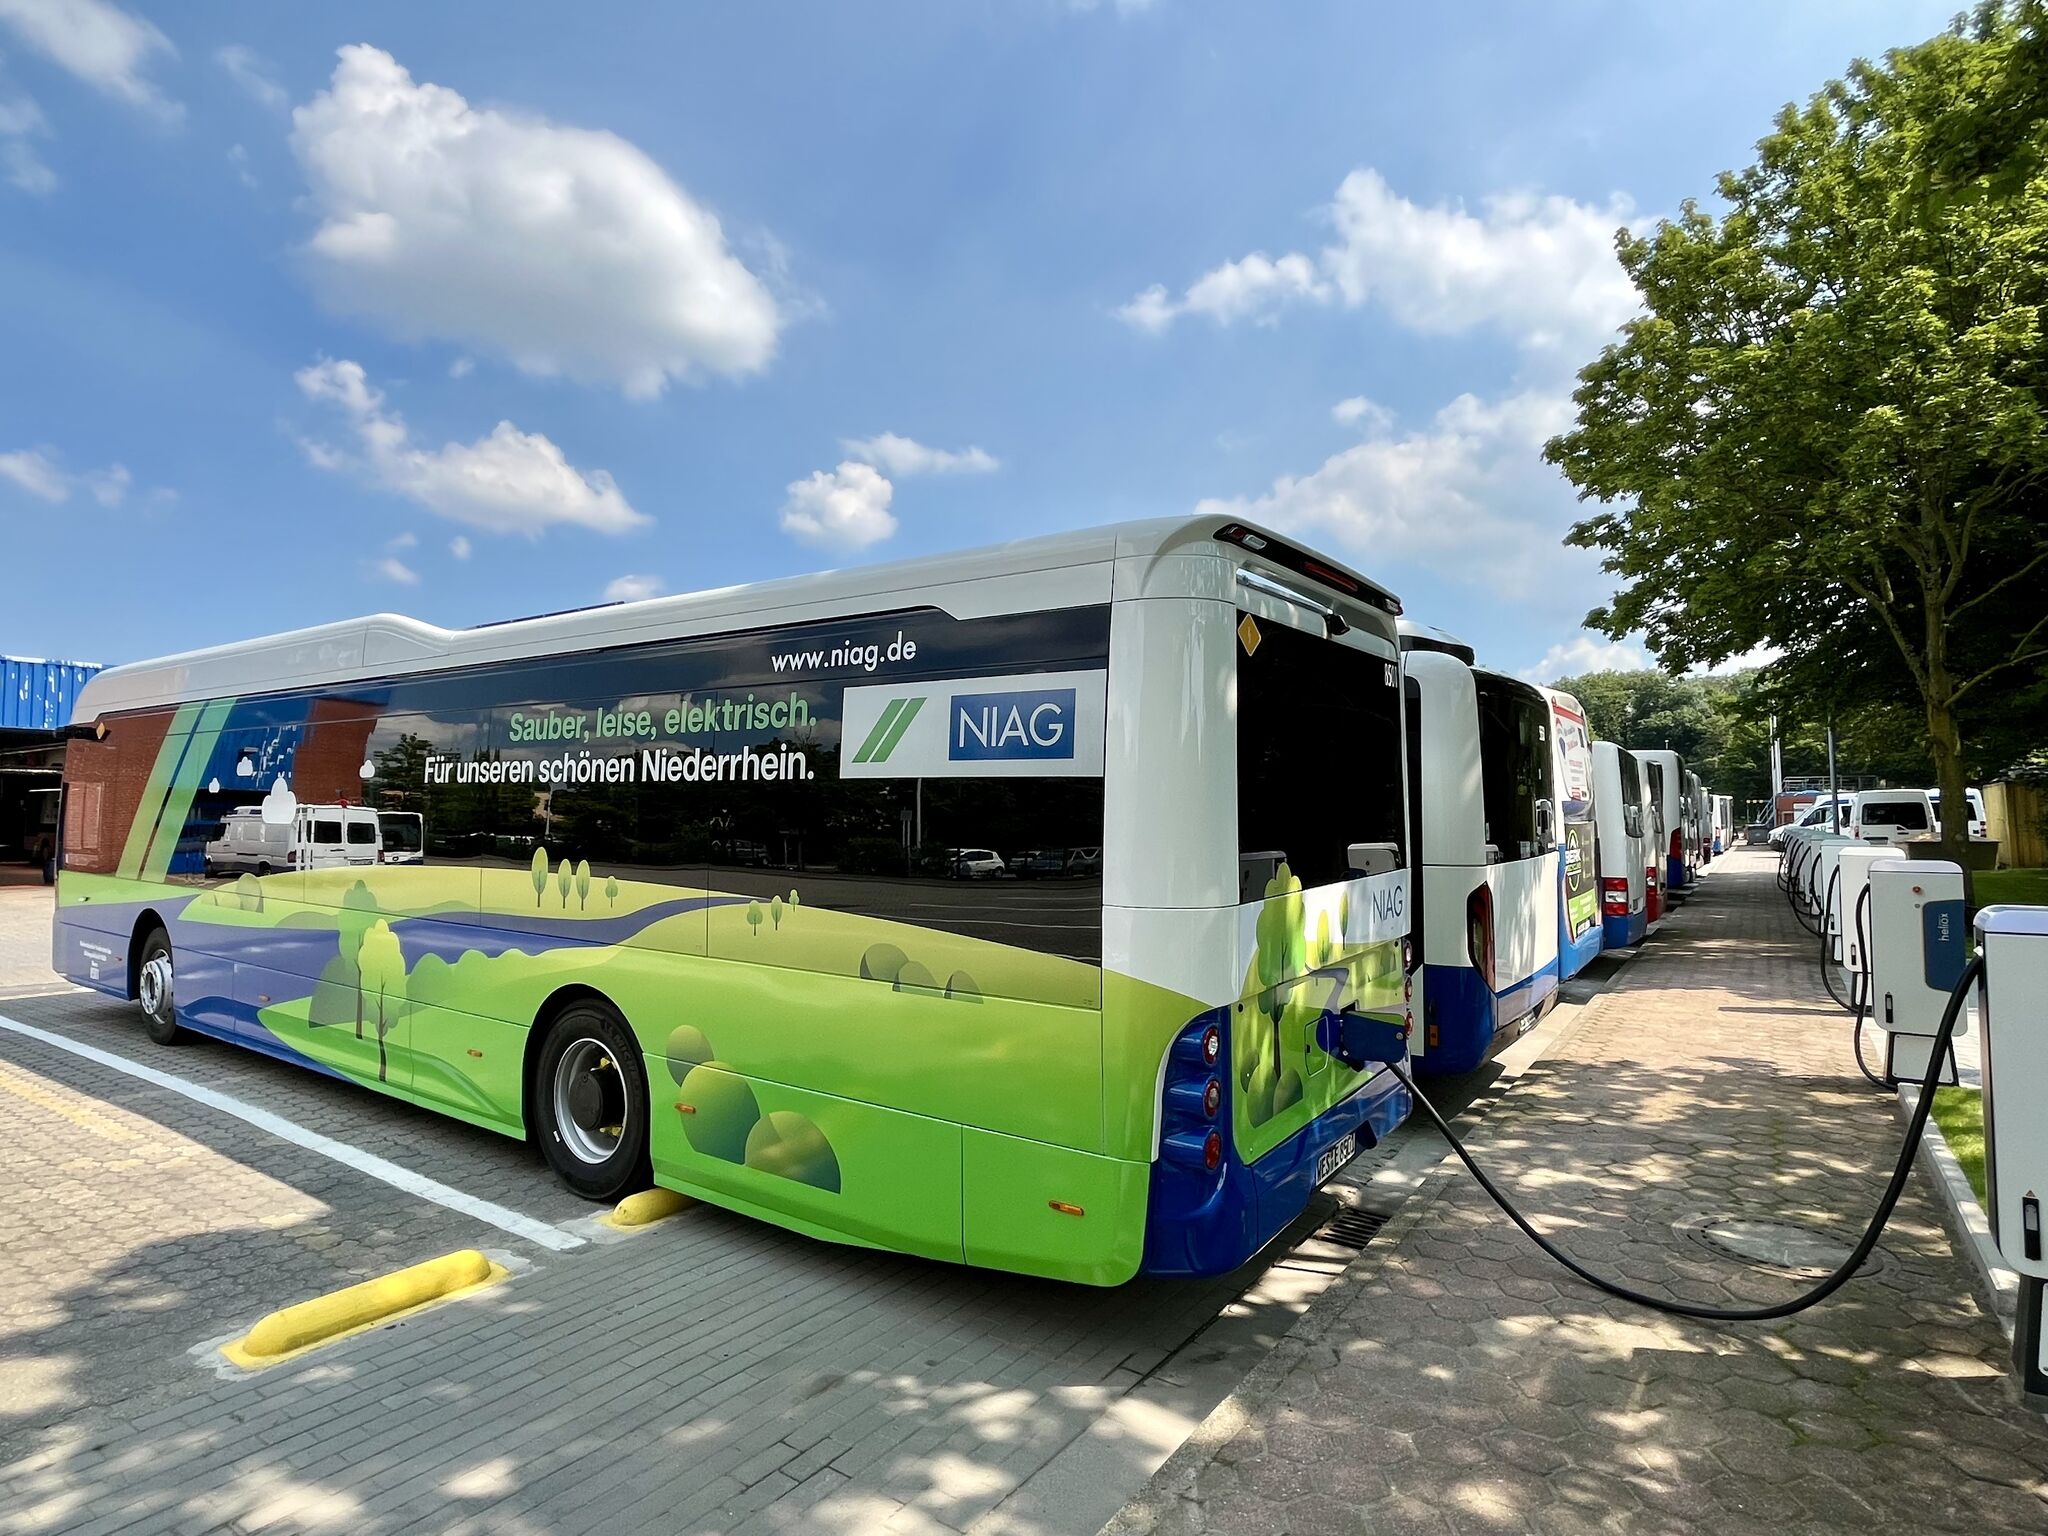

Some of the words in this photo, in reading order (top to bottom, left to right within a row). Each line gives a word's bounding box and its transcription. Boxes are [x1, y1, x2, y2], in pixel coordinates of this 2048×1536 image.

[771, 630, 916, 672] www.niag.de
[509, 710, 589, 743] Sauber,
[595, 707, 657, 740] leise,
[664, 691, 817, 734] elektrisch.
[959, 702, 1064, 748] NIAG
[424, 755, 453, 784] Für
[456, 759, 534, 784] unseren
[538, 750, 635, 784] schönen
[641, 743, 815, 782] Niederrhein.
[1372, 885, 1403, 924] NIAG
[1937, 912, 1950, 942] heliox
